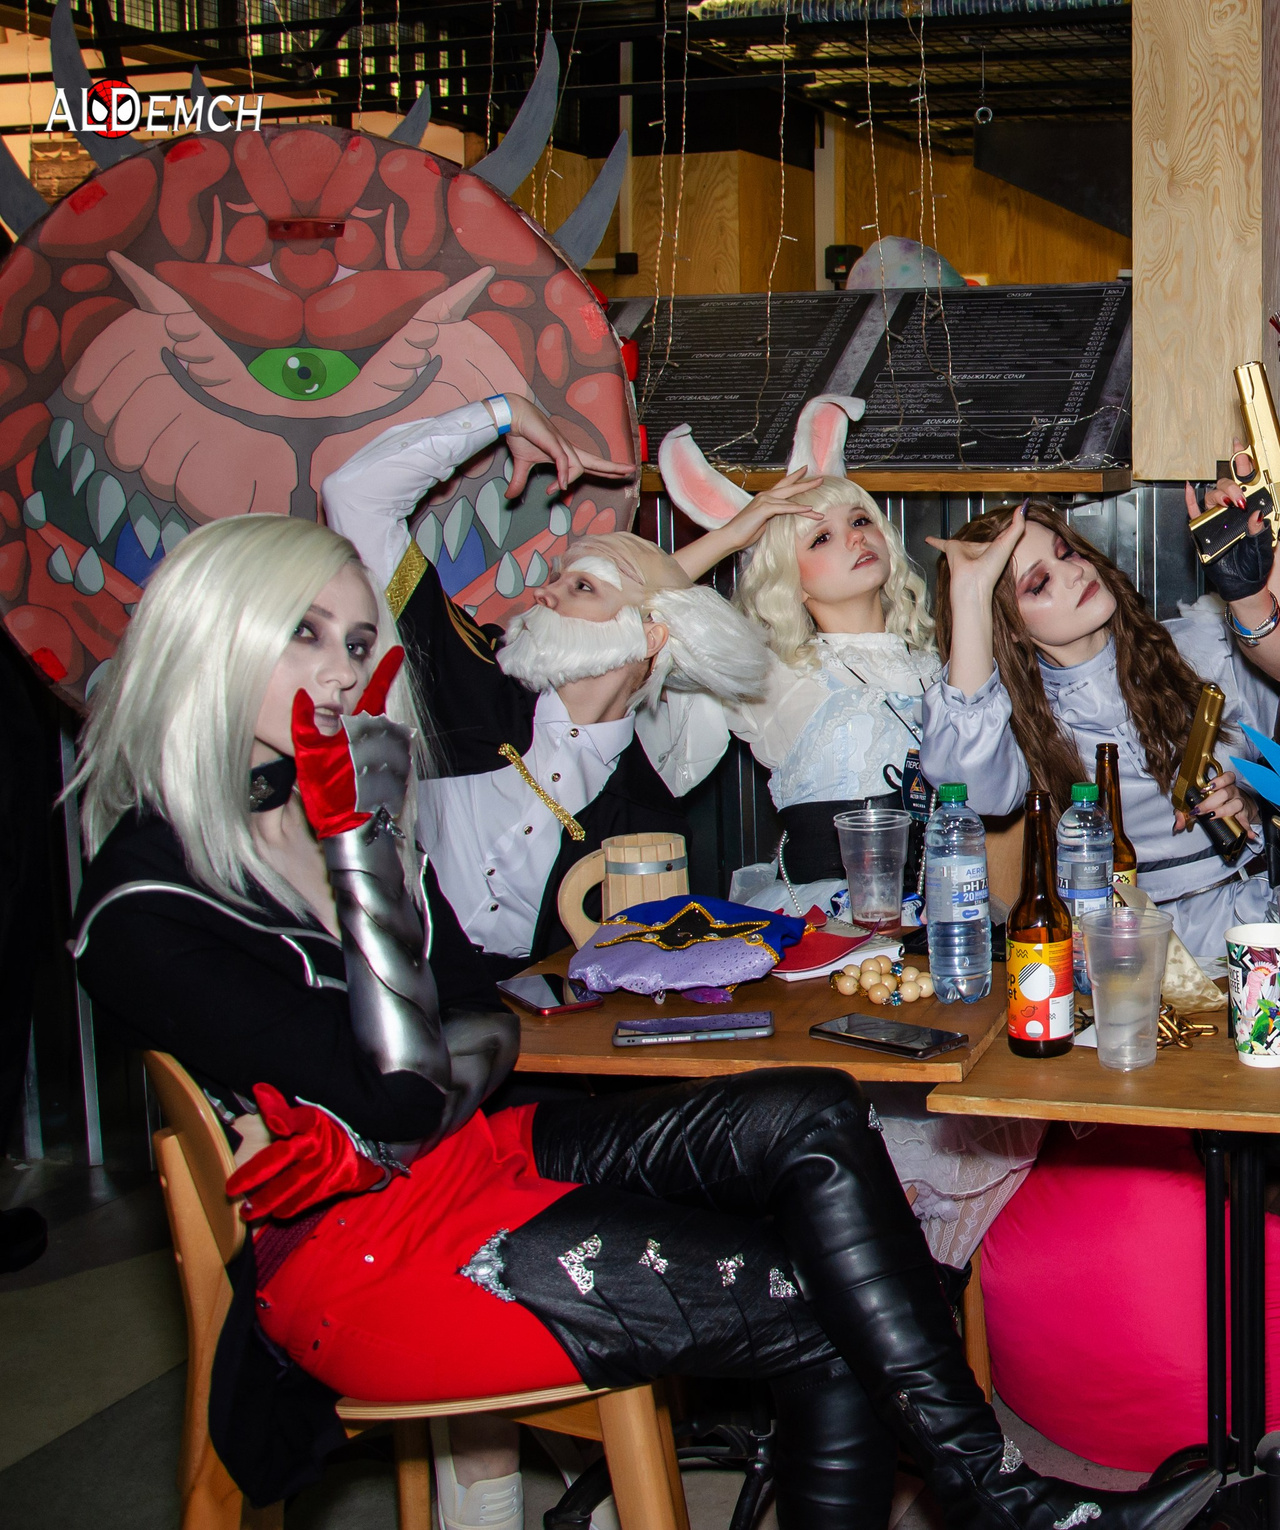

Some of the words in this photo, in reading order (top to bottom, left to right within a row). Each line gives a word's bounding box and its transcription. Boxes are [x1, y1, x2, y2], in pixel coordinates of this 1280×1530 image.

[966, 866, 984, 876] AERO
[963, 881, 979, 892] pH
[963, 893, 974, 902] 20
